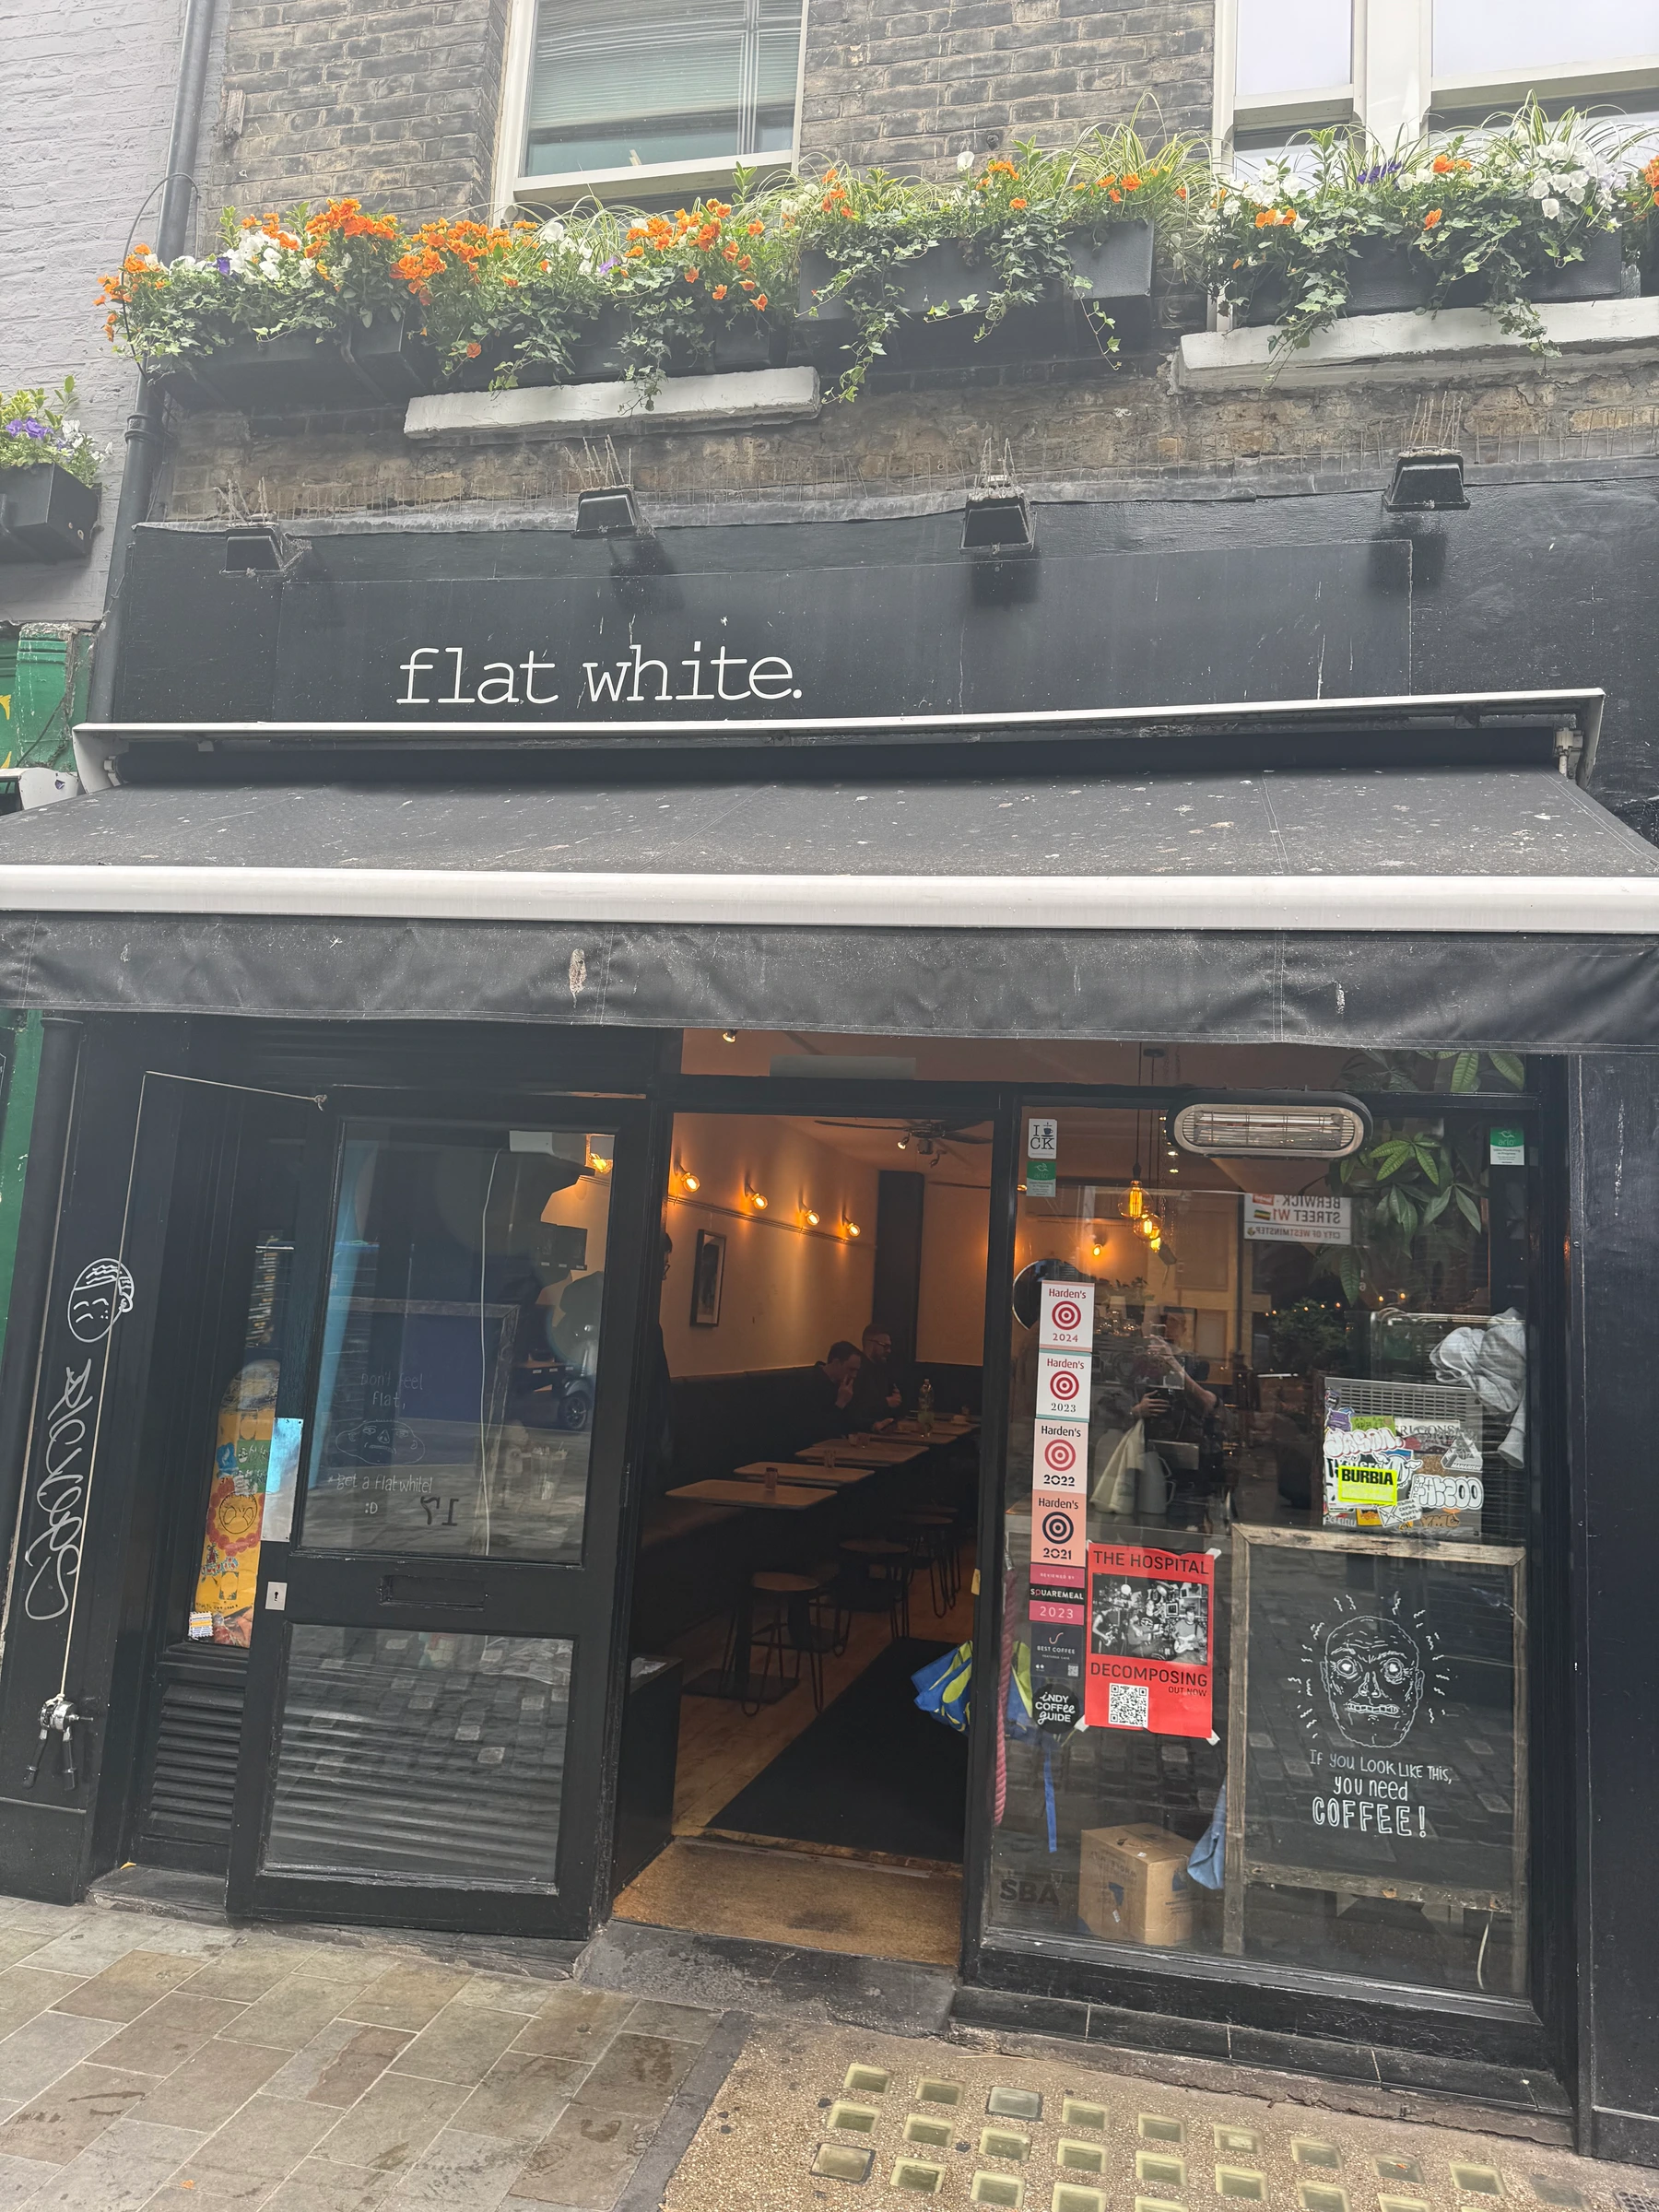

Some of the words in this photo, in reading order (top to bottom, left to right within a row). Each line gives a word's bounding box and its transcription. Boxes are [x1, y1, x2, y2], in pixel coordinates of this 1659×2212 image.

[396, 646, 559, 704] flat
[582, 641, 802, 703] white.
[1030, 1136, 1055, 1150] CK
[1049, 1288, 1087, 1300] Harden's
[1053, 1333, 1078, 1343] 2024
[1046, 1358, 1085, 1370] Harden's
[1051, 1402, 1077, 1413] 2023
[1041, 1425, 1081, 1438] Harden's
[1043, 1474, 1076, 1487] 2022
[1341, 1468, 1394, 1486] BURBIA
[1038, 1497, 1079, 1510] Harden's
[1042, 1547, 1072, 1560] 2021
[1093, 1550, 1125, 1566] THE
[1130, 1554, 1209, 1574] HOSPITAL
[1030, 1588, 1084, 1600] SQUAREMEAL
[1040, 1606, 1074, 1619] 2023
[1090, 1662, 1207, 1688] DECOMPOSING
[1168, 1686, 1183, 1694] OUT
[1186, 1688, 1207, 1697] NOW
[1360, 1756, 1396, 1775] LOOK
[1398, 1761, 1424, 1779] LIKE
[1369, 1779, 1408, 1802] need
[1312, 1796, 1427, 1838] COFFEE!
